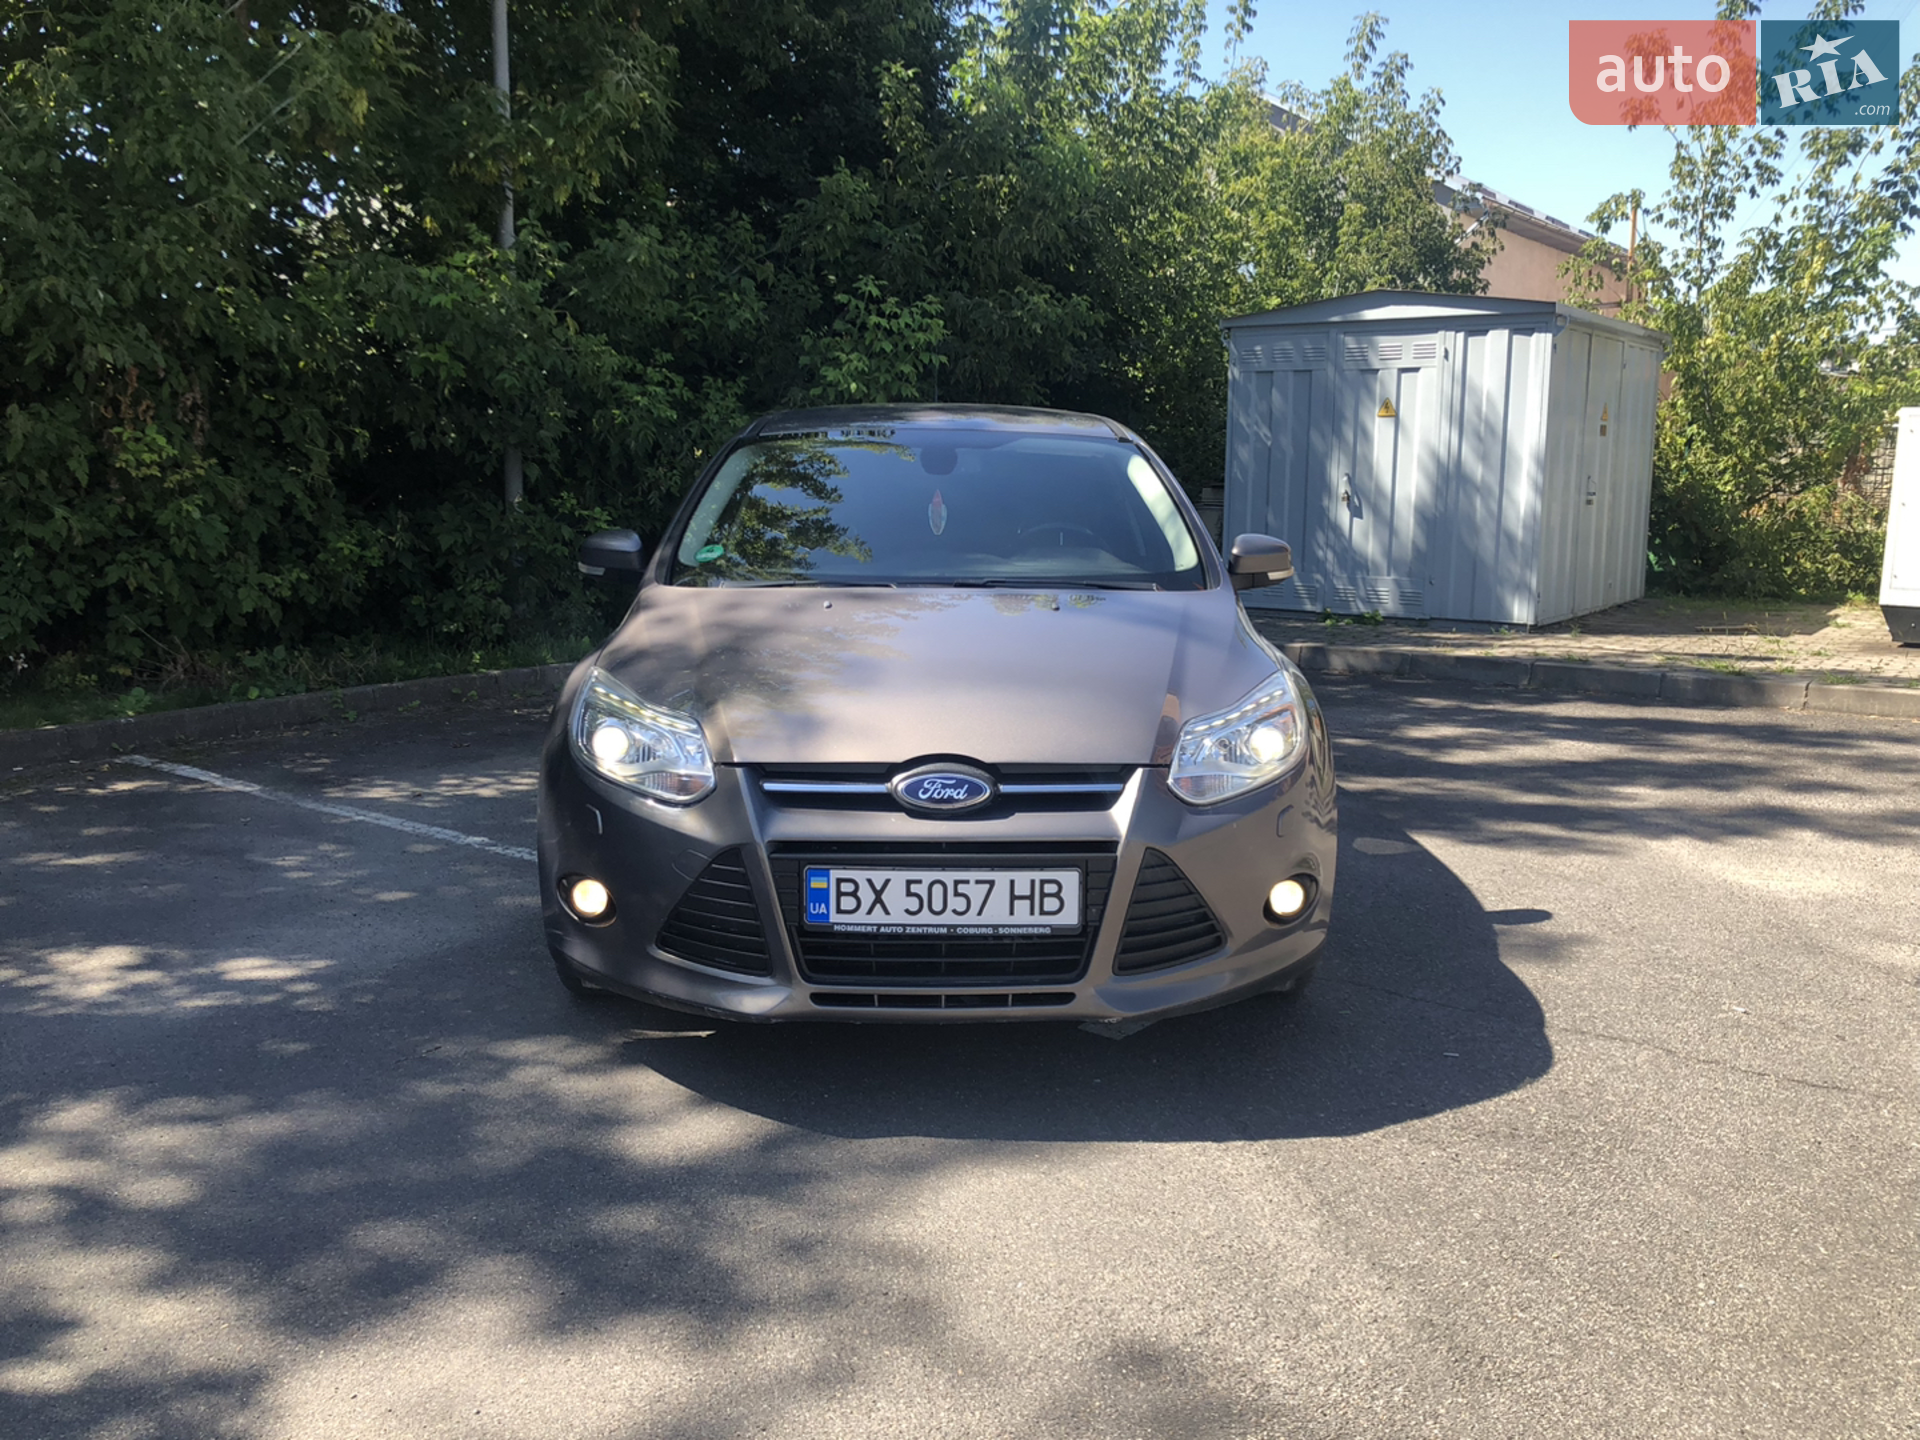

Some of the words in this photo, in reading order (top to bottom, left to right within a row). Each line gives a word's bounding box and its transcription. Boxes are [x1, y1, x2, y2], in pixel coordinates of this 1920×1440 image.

[918, 778, 969, 800] Ford
[835, 877, 892, 916] BX
[903, 878, 996, 917] 5057
[1009, 878, 1066, 917] HB
[809, 902, 828, 915] UA
[833, 924, 878, 933] HOMMERT
[905, 926, 948, 934] ZENTRUM
